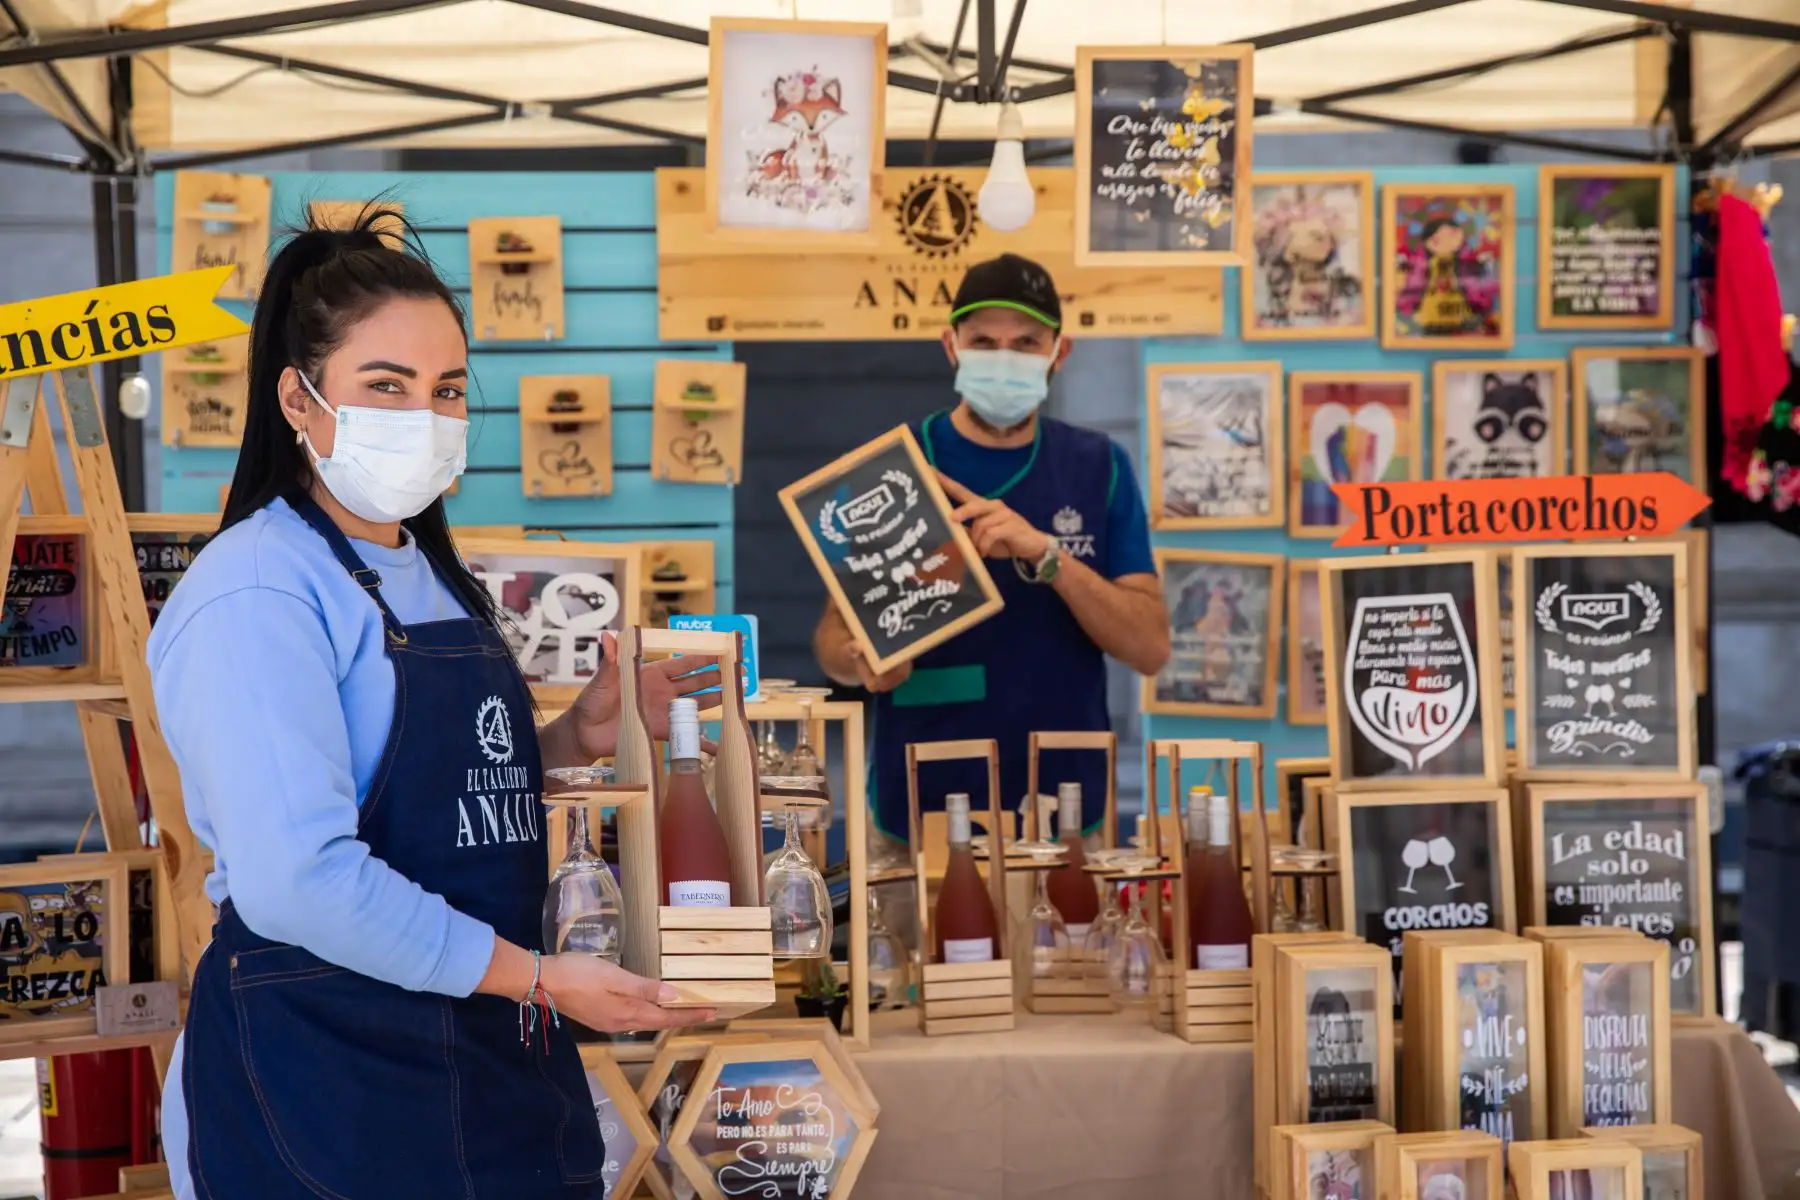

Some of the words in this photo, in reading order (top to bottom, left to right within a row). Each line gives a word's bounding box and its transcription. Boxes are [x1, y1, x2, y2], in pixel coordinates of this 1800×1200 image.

[854, 277, 953, 308] ANA
[0, 299, 176, 375] ncías
[676, 619, 713, 629] niubiz
[1370, 669, 1409, 687] para
[1374, 691, 1448, 737] Vino
[1546, 716, 1655, 753] Brindis
[467, 768, 481, 791] EL
[456, 793, 538, 847] ANALU
[1552, 831, 1594, 865] La
[1603, 820, 1686, 860] edad
[1587, 851, 1649, 876] solo
[1554, 885, 1575, 905] es
[1579, 876, 1683, 913] importante
[1383, 902, 1489, 930] CORCHOS
[1580, 905, 1602, 927] si
[1613, 912, 1675, 935] eres
[0, 917, 26, 949] A
[1477, 1015, 1513, 1058] VIVE
[1584, 1014, 1648, 1050] DISFRUTA
[708, 1087, 737, 1119] Te
[736, 1088, 775, 1119] Amo
[1584, 1079, 1648, 1114] PEQUEÑAS
[717, 1126, 739, 1139] PERO
[741, 1126, 753, 1138] NO
[756, 1126, 767, 1138] ES
[769, 1125, 793, 1138] PARA
[776, 1143, 787, 1154] ES
[718, 1140, 834, 1197] Siempre
